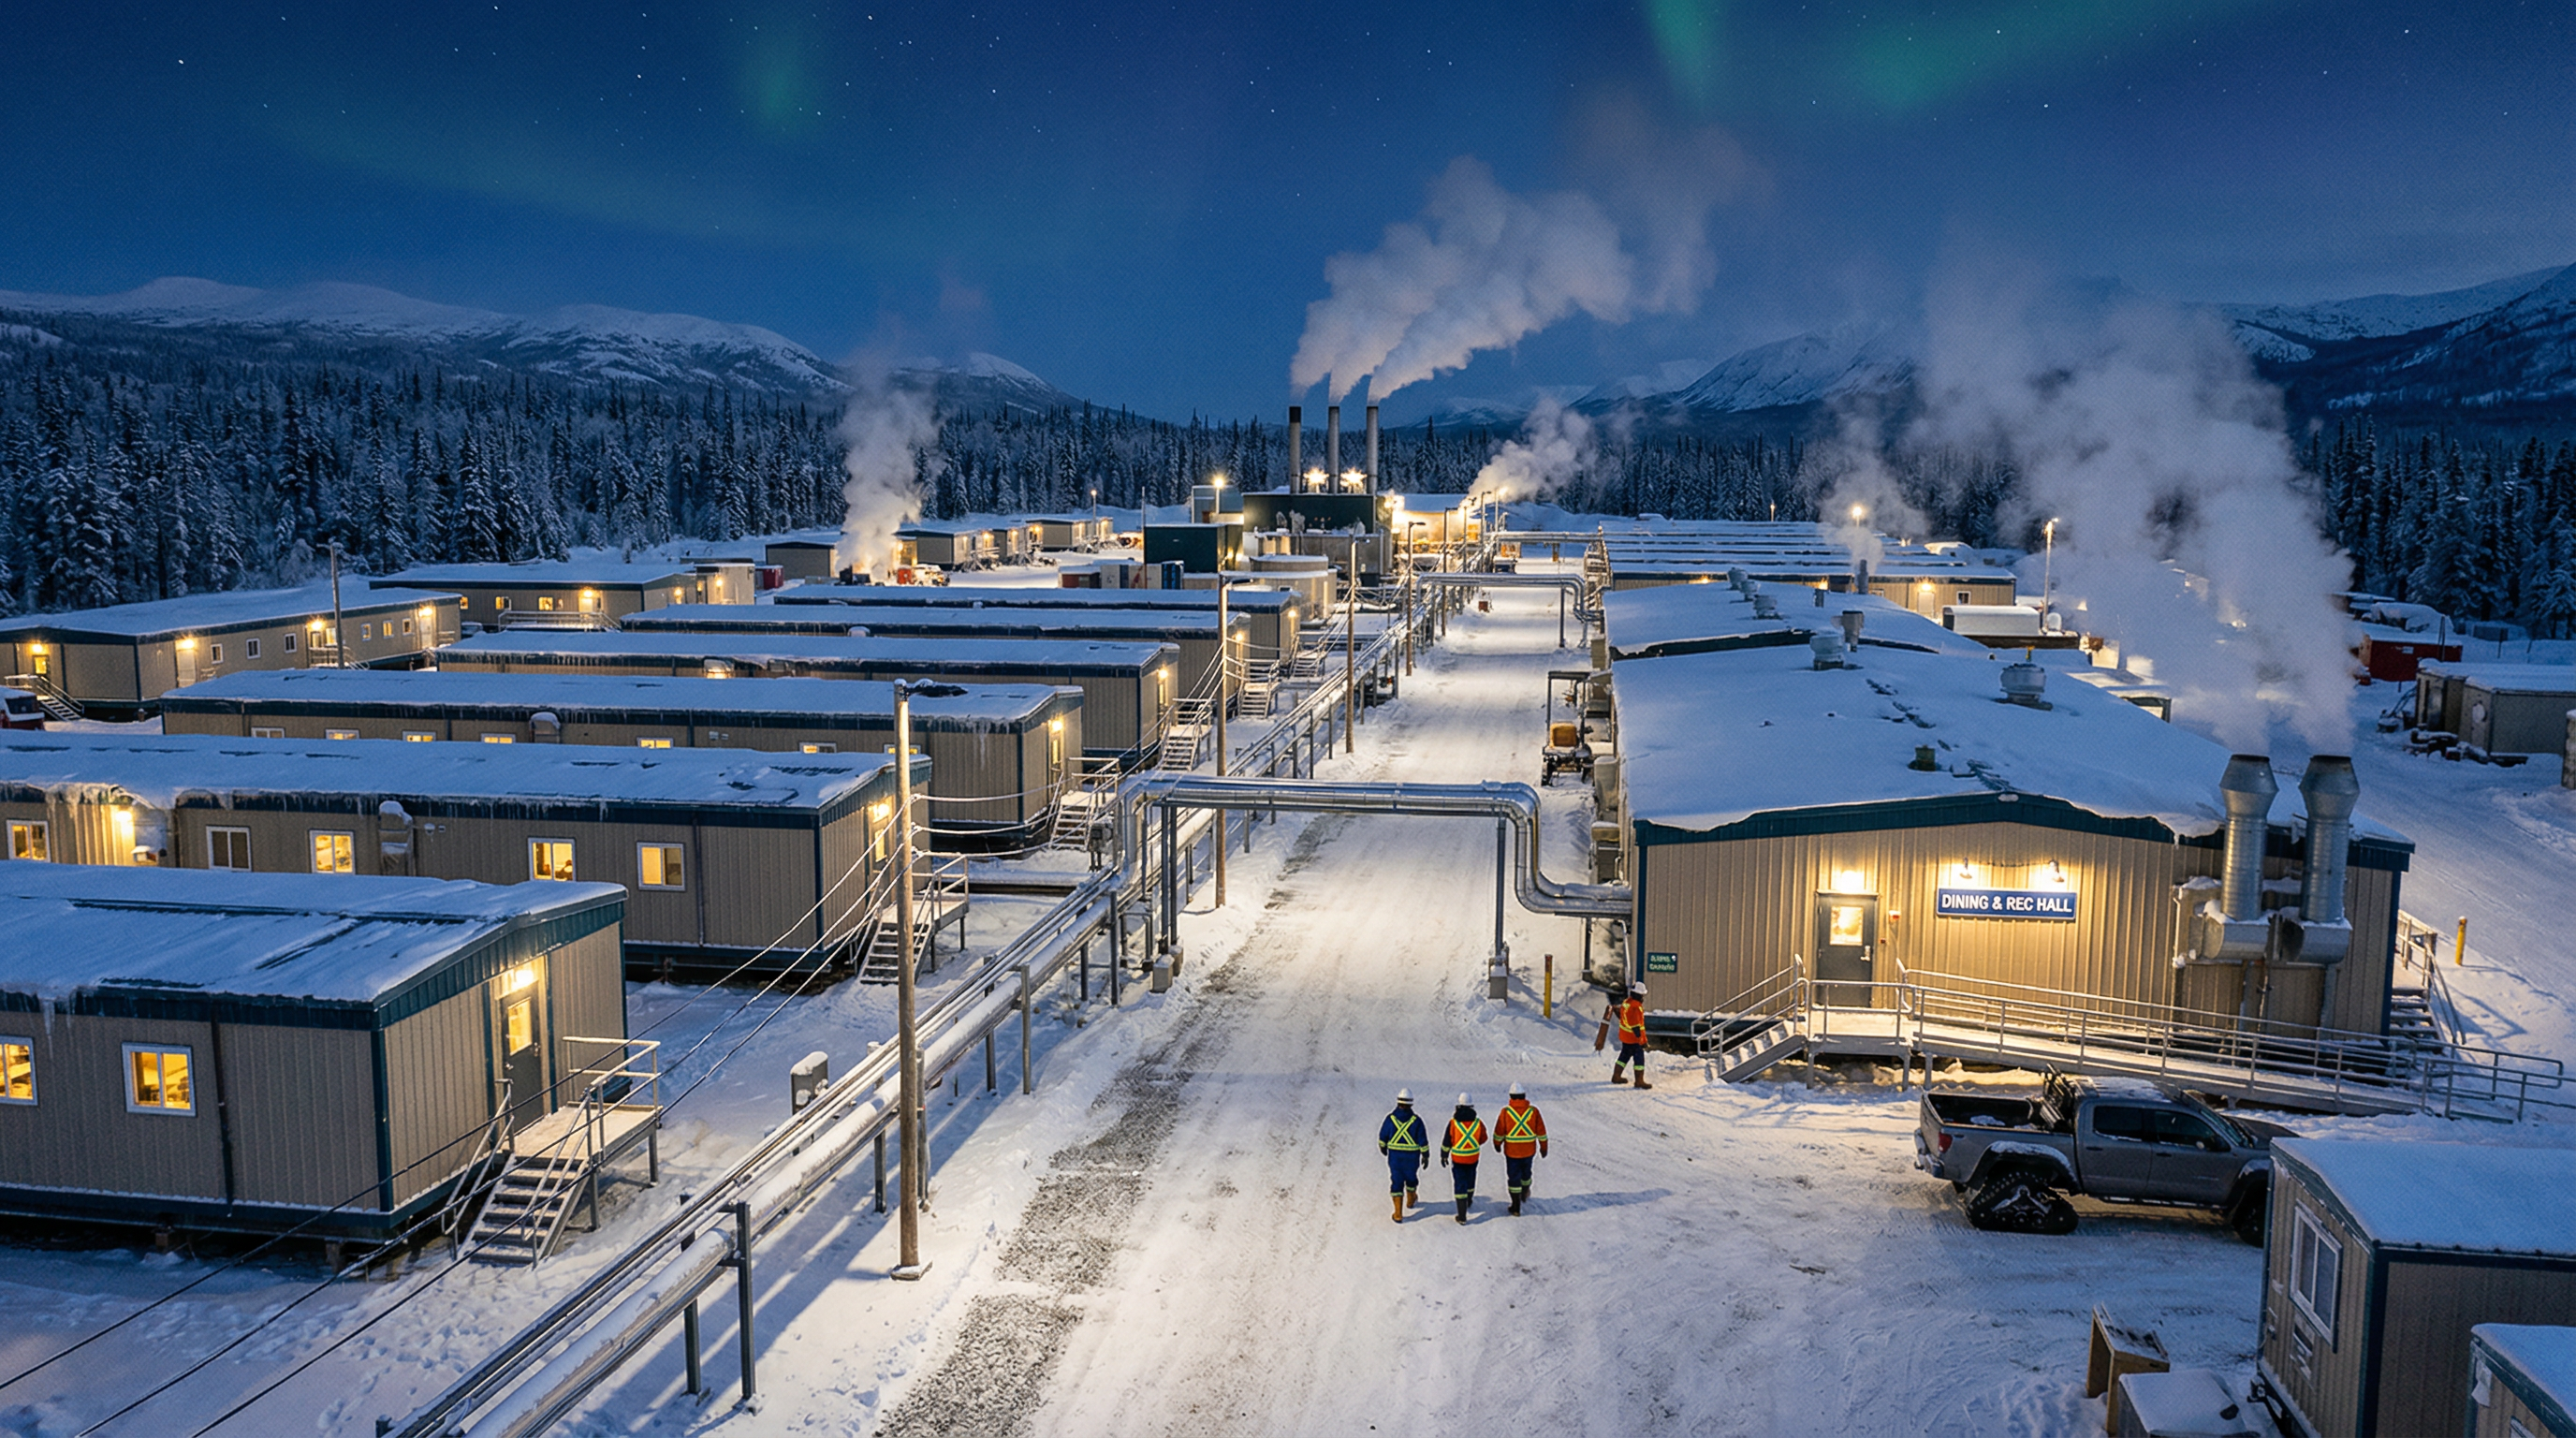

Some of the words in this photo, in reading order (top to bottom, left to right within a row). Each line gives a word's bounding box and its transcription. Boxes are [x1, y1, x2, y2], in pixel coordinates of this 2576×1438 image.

[1941, 894, 1989, 910] DINING
[1992, 896, 2002, 910] &
[2006, 897, 2033, 911] REC
[2037, 898, 2072, 913] HALL
